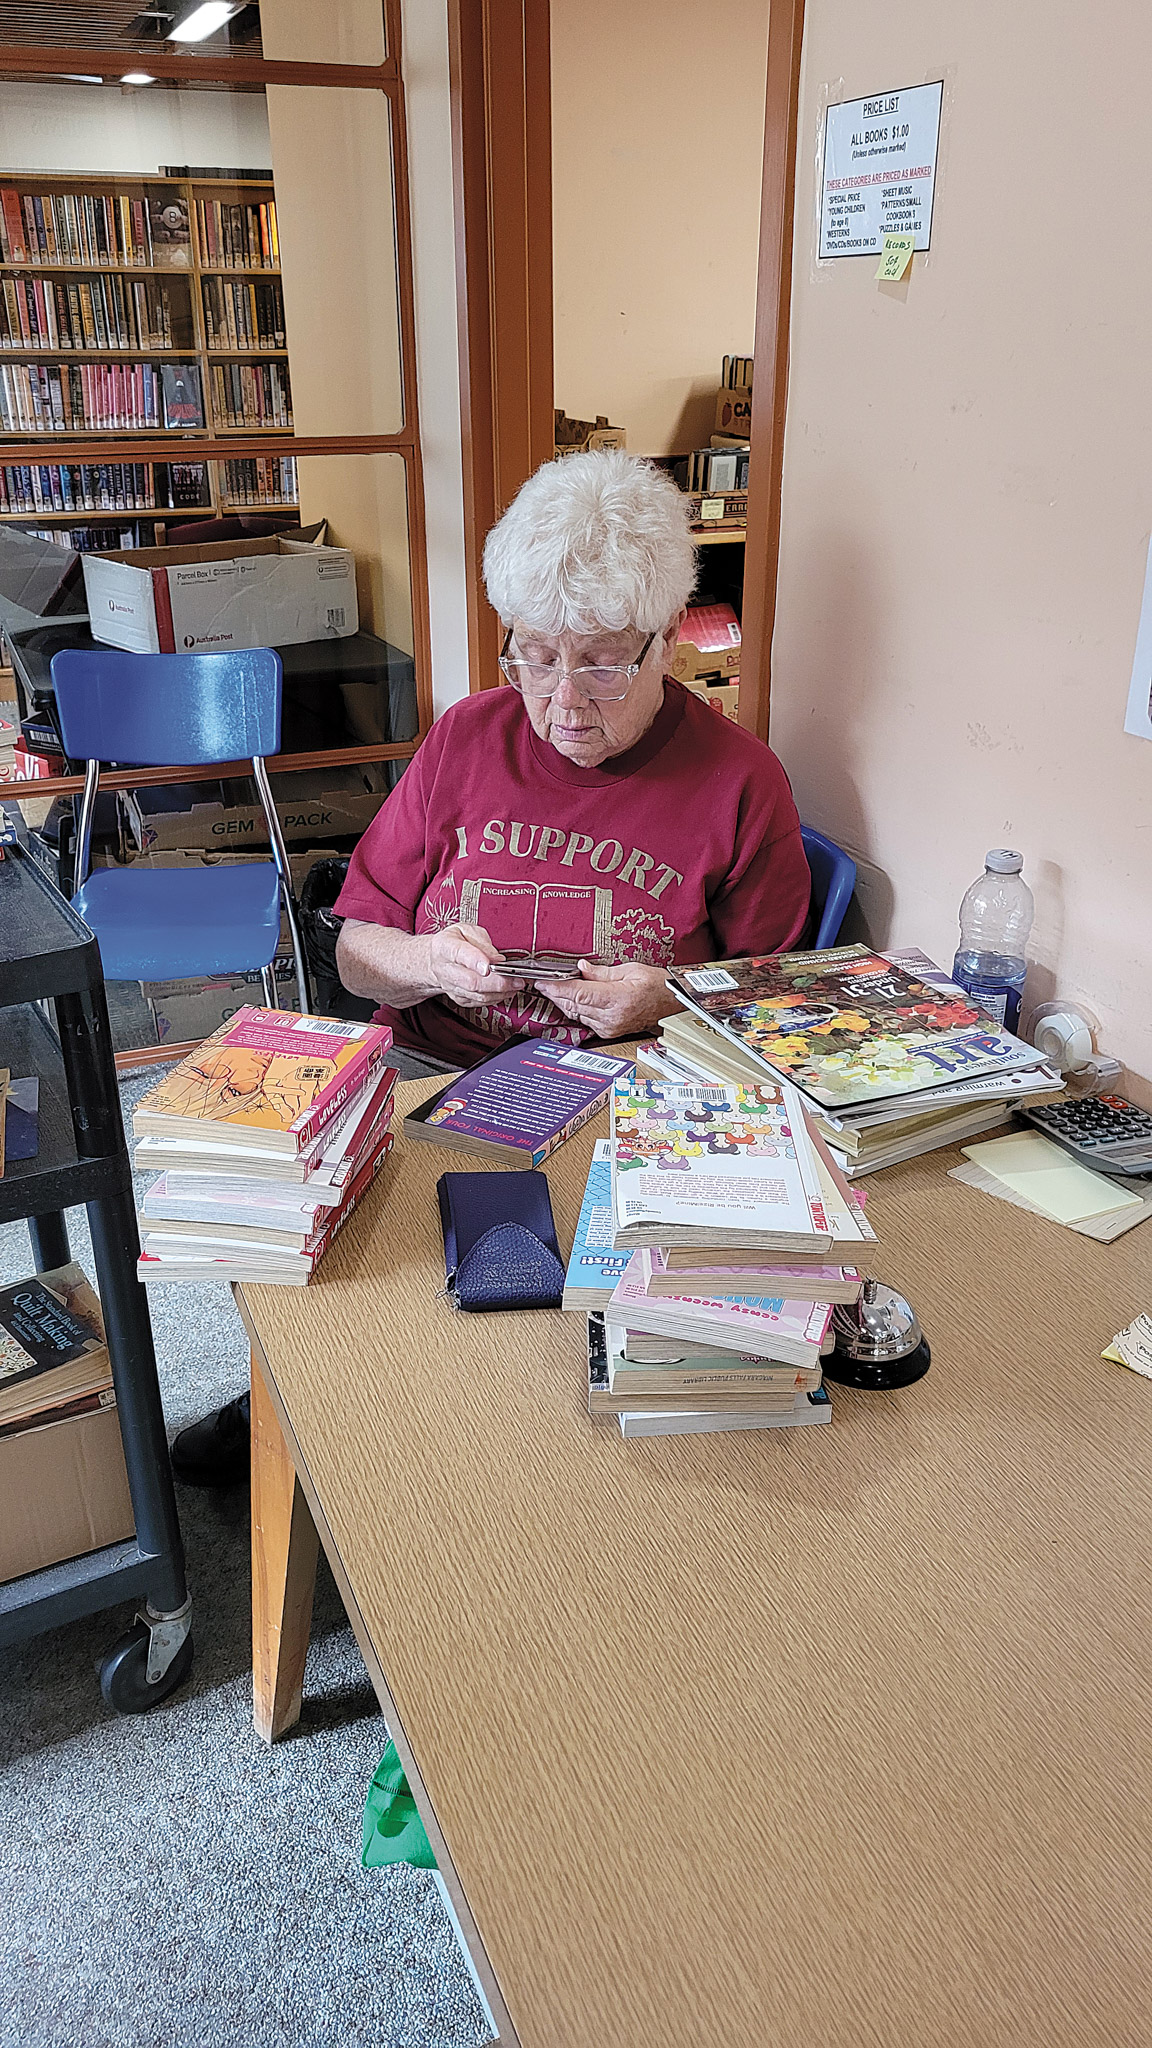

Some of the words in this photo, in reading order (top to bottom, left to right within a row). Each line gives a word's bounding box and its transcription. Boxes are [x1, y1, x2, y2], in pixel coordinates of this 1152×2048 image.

[863, 103, 883, 116] PRICE
[885, 97, 899, 112] LIST
[851, 133, 863, 146] ALL
[865, 128, 888, 144] BOOKS
[892, 124, 909, 140] $1.00
[868, 145, 888, 157] otherwise
[827, 179, 841, 189] THESE
[842, 174, 871, 187] CATEGORIES
[872, 173, 882, 183] ARE
[883, 170, 901, 182] PRICED
[902, 168, 908, 178] AS
[910, 166, 931, 177] MARKED
[848, 193, 861, 202] PRICE
[898, 186, 913, 195] MUSIC
[844, 204, 865, 214] CHILDREN
[196, 634, 220, 644] Australia
[220, 633, 234, 641] Post
[212, 819, 254, 835] GEM
[284, 811, 333, 828] PACK
[455, 826, 469, 860] I
[479, 820, 684, 901] SUPPORT
[482, 887, 536, 896] INCREASING
[542, 890, 591, 899] KNOWLEDGE
[862, 975, 902, 989] Under
[840, 985, 871, 998] 31
[875, 985, 907, 999] 21
[914, 1036, 1013, 1073] art
[961, 1051, 1026, 1072] southwest
[956, 1081, 1006, 1093] warming
[318, 1084, 348, 1126] LOVELESS
[446, 1119, 471, 1130] FOUR
[472, 1126, 515, 1141] ORIGINAL
[517, 1139, 533, 1147] THE
[580, 1256, 623, 1267] First!
[602, 1268, 625, 1277] ove
[36, 1292, 46, 1305] The
[60, 1316, 76, 1333] Book
[11, 1292, 43, 1318] Quilt
[35, 1313, 74, 1351] Making
[21, 1317, 45, 1343] Collecting
[682, 1377, 707, 1385] LIBRARY
